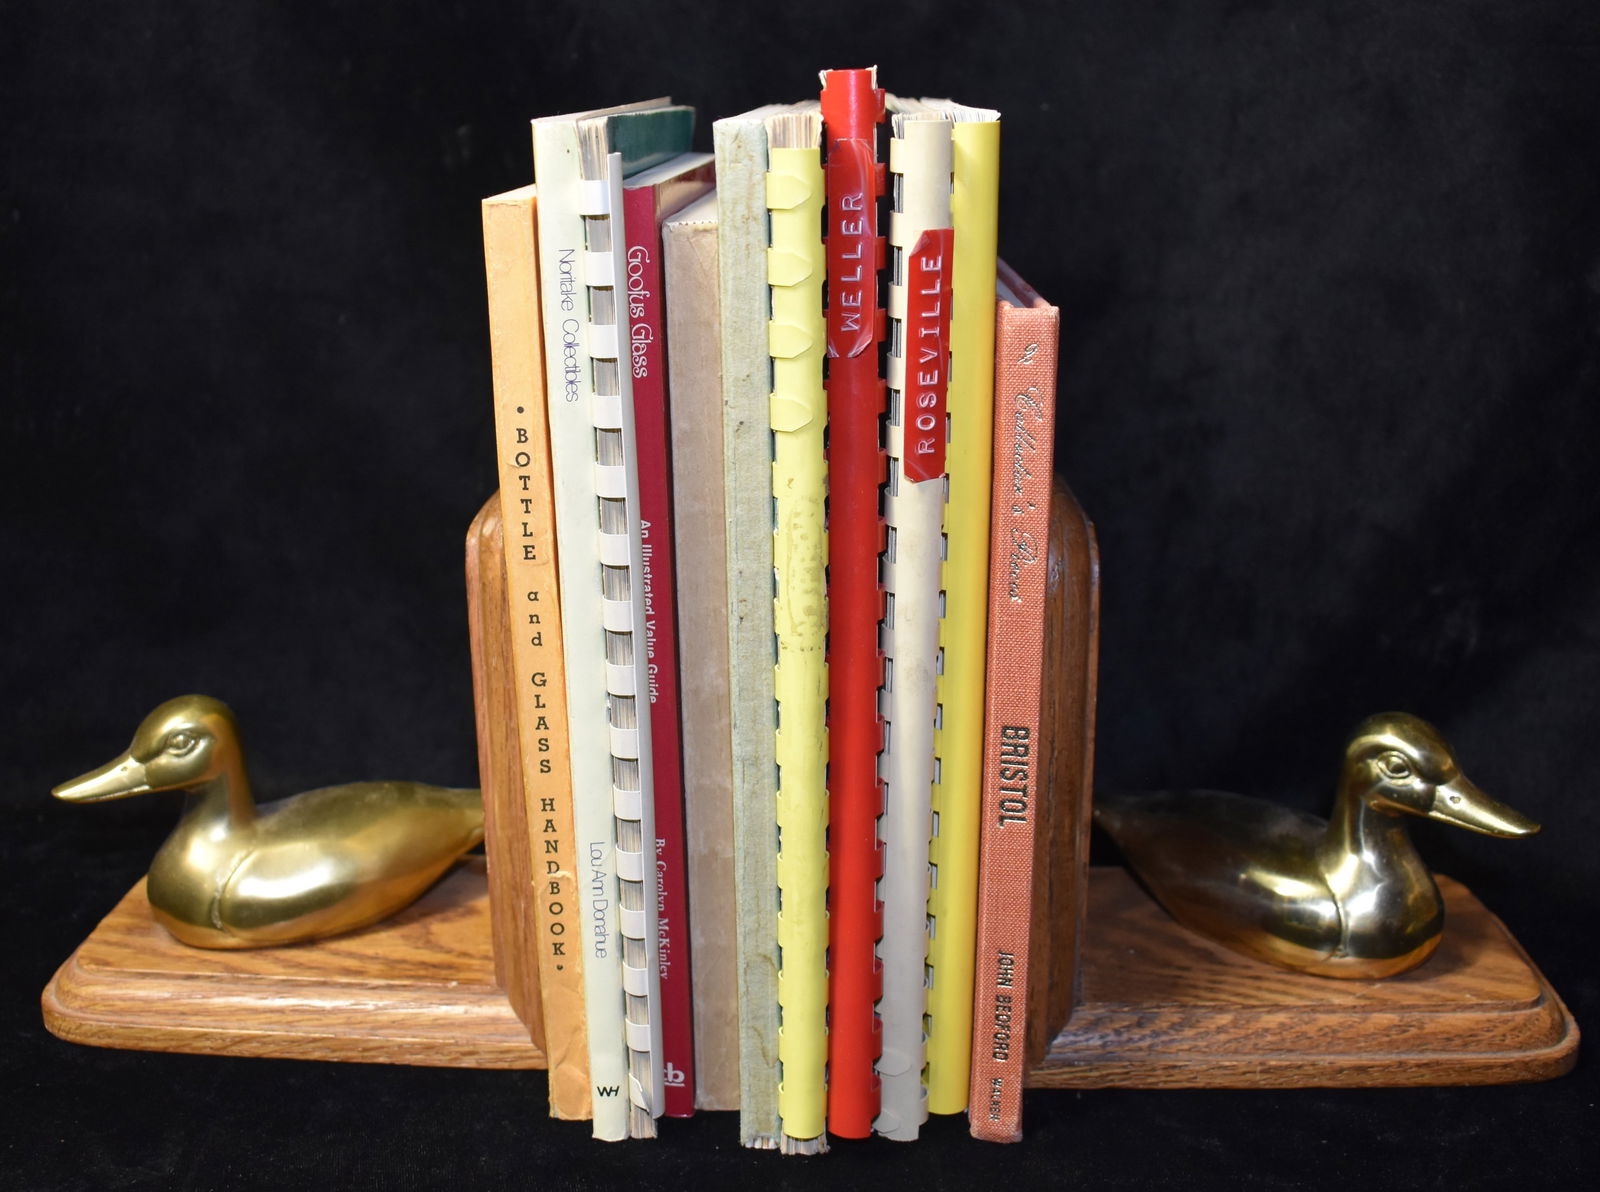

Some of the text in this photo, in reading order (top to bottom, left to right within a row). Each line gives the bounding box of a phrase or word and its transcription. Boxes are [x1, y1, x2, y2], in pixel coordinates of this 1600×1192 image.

[557, 248, 580, 403] Noritake Collectibles
[627, 245, 654, 379] Goofus Glass
[839, 192, 865, 332] WELLER
[915, 253, 943, 455] ROSEVILLE
[640, 519, 660, 704] An Illustrated Value Guide
[515, 428, 566, 956] BOTTLE and GLASS HANDBOOK
[998, 725, 1030, 829] BRISTOL
[589, 841, 610, 960] Lou Ann Donahue
[657, 917, 672, 980] McKinley
[992, 951, 1016, 1063] JOHN BEDFORD
[596, 1085, 620, 1097] WH
